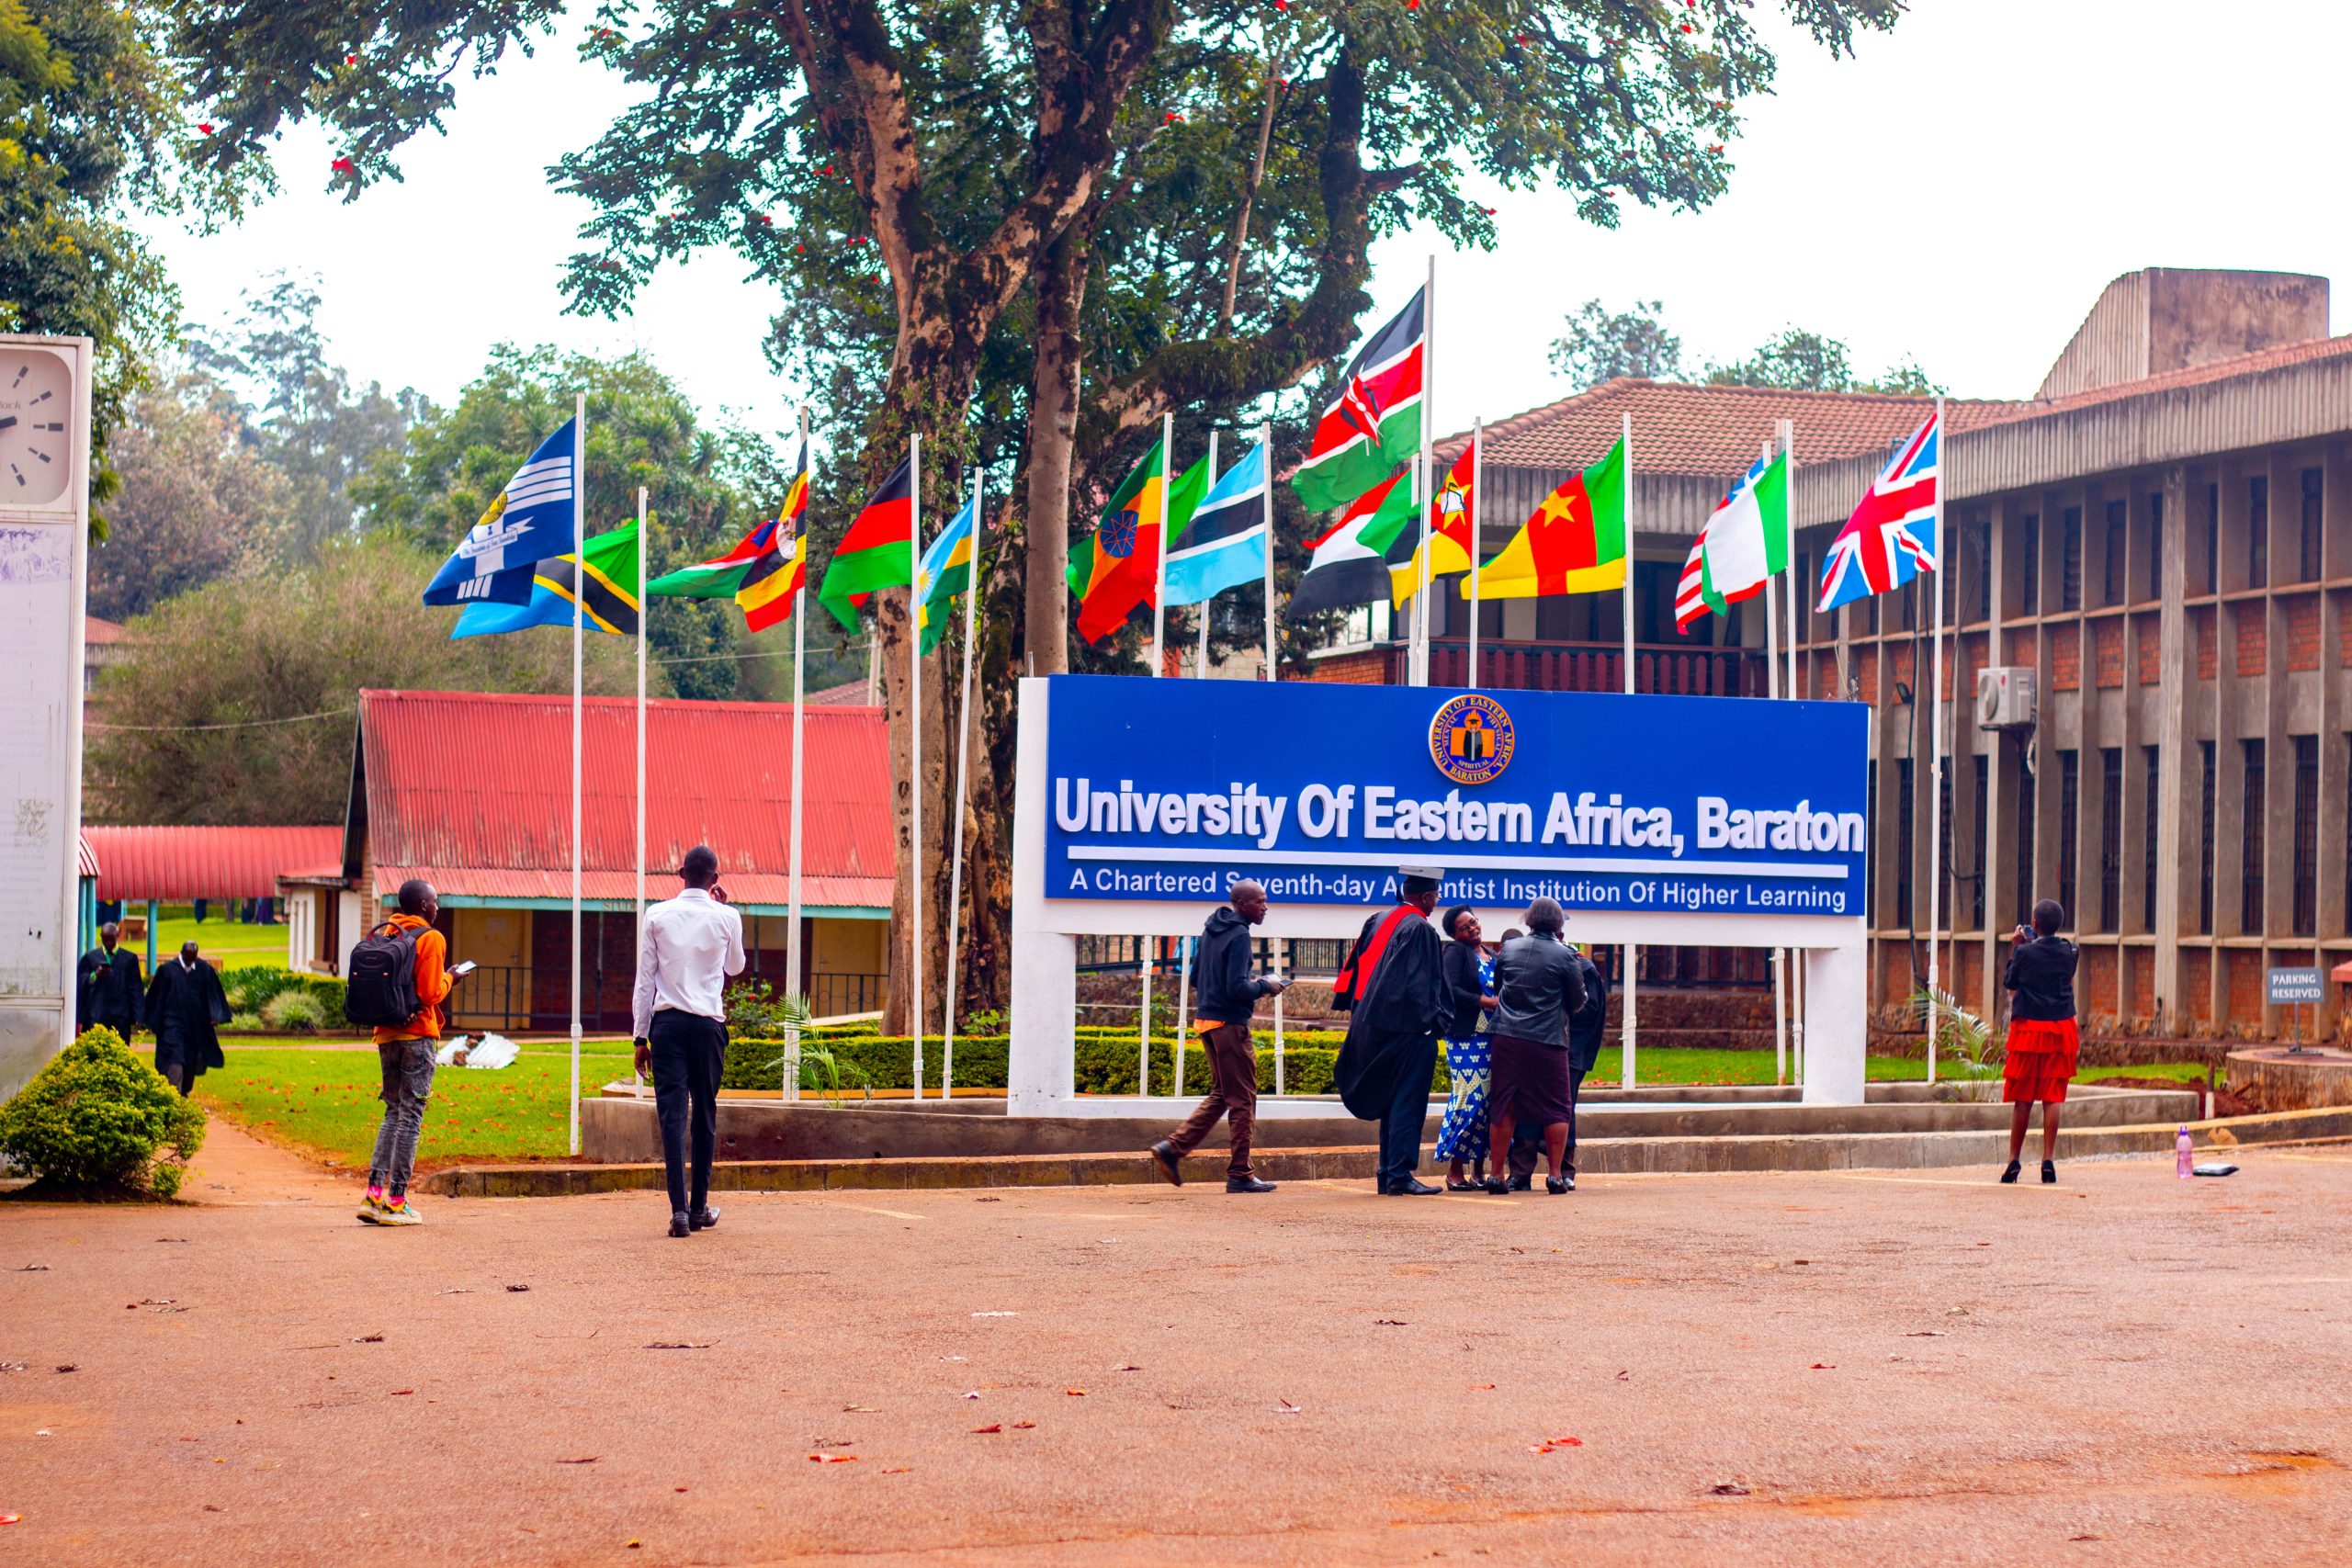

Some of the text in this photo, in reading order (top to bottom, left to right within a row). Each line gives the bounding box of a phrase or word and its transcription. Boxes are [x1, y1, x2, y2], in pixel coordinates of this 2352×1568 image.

[1453, 698, 1466, 709] OF
[1470, 697, 1509, 727] EASTERN
[1434, 706, 1453, 766] UNIVERSITY
[1457, 760, 1490, 770] SPIRITUAL
[1450, 766, 1492, 781] BARATON
[1056, 777, 1864, 858] University Of Eastern Africa, Baraton
[1069, 868, 1847, 913] A Chartered Sventh-day Antist Institution Of Higher Learning
[2272, 974, 2316, 985] PARKING
[2271, 987, 2321, 999] RESERVED
